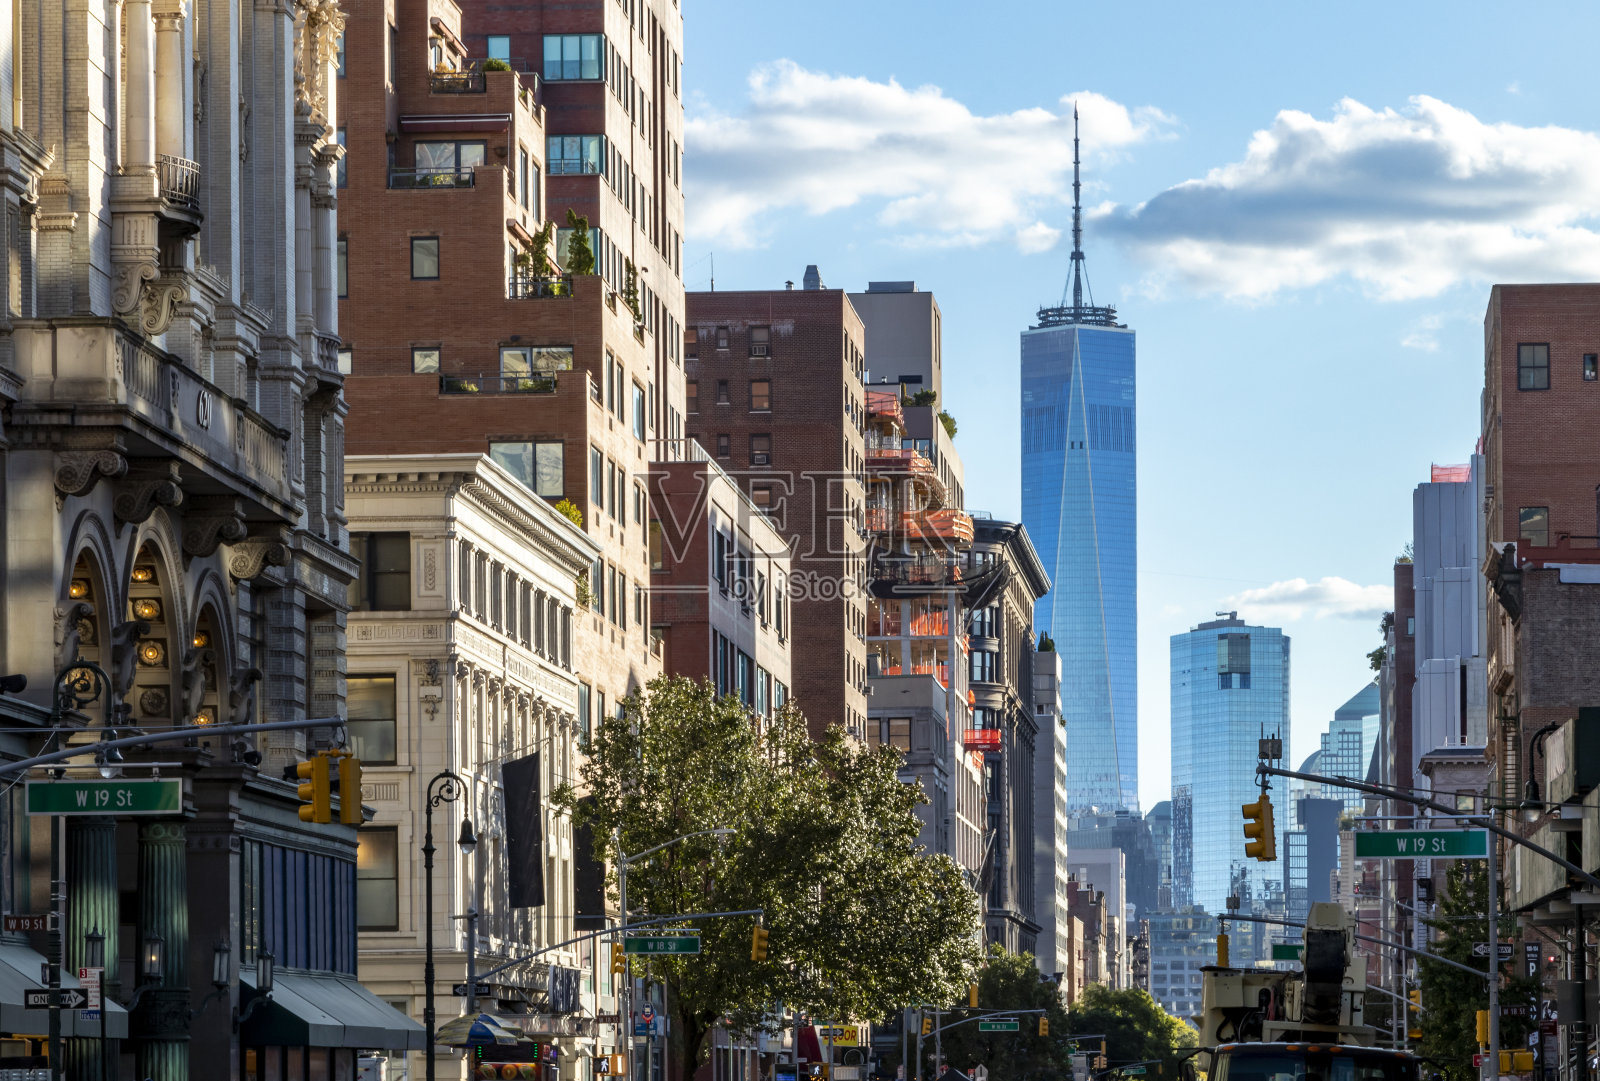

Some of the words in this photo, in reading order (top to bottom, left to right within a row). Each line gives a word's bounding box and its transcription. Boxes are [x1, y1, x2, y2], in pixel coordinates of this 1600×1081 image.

[198, 390, 212, 430] 620
[75, 790, 88, 807] W
[95, 790, 109, 806] 19
[116, 789, 132, 806] St
[1396, 838, 1407, 852] W
[1413, 838, 1426, 852] 19
[1431, 837, 1446, 852] St
[8, 920, 17, 930] W
[21, 919, 30, 929] 19
[34, 919, 43, 930] St
[647, 941, 654, 950] W
[656, 941, 664, 950] 18
[667, 941, 676, 949] St
[81, 969, 86, 978] 3
[60, 995, 79, 1004] WAY
[824, 1029, 857, 1042] QUOR
